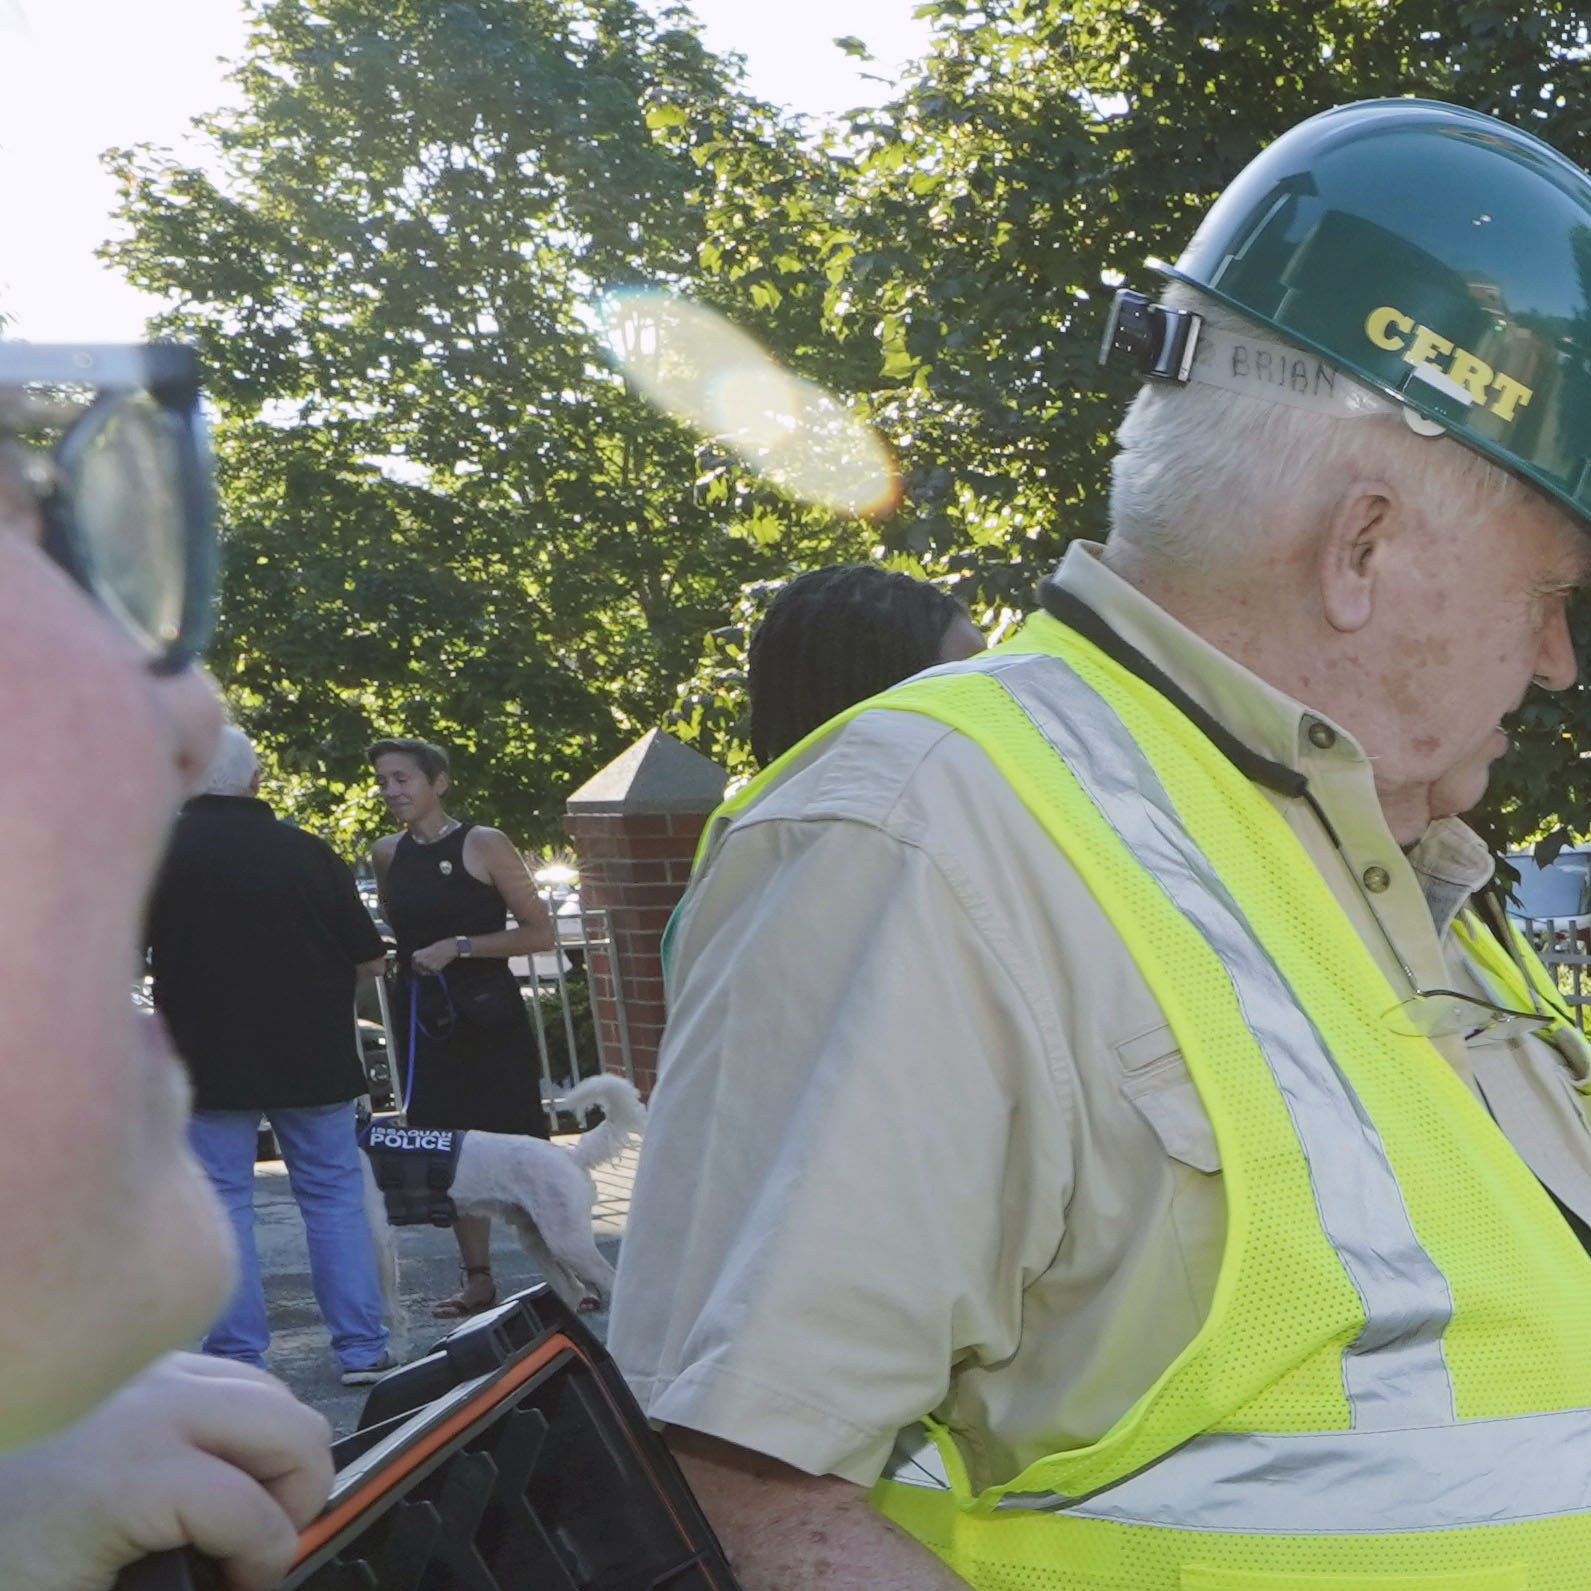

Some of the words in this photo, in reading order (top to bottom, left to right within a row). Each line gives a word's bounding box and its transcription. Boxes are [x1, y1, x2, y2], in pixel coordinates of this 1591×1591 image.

[1231, 344, 1340, 399] BRIAN
[1366, 306, 1533, 422] CERT
[369, 1133, 452, 1152] POLICE
[371, 1126, 453, 1138] ISSAQUAH
